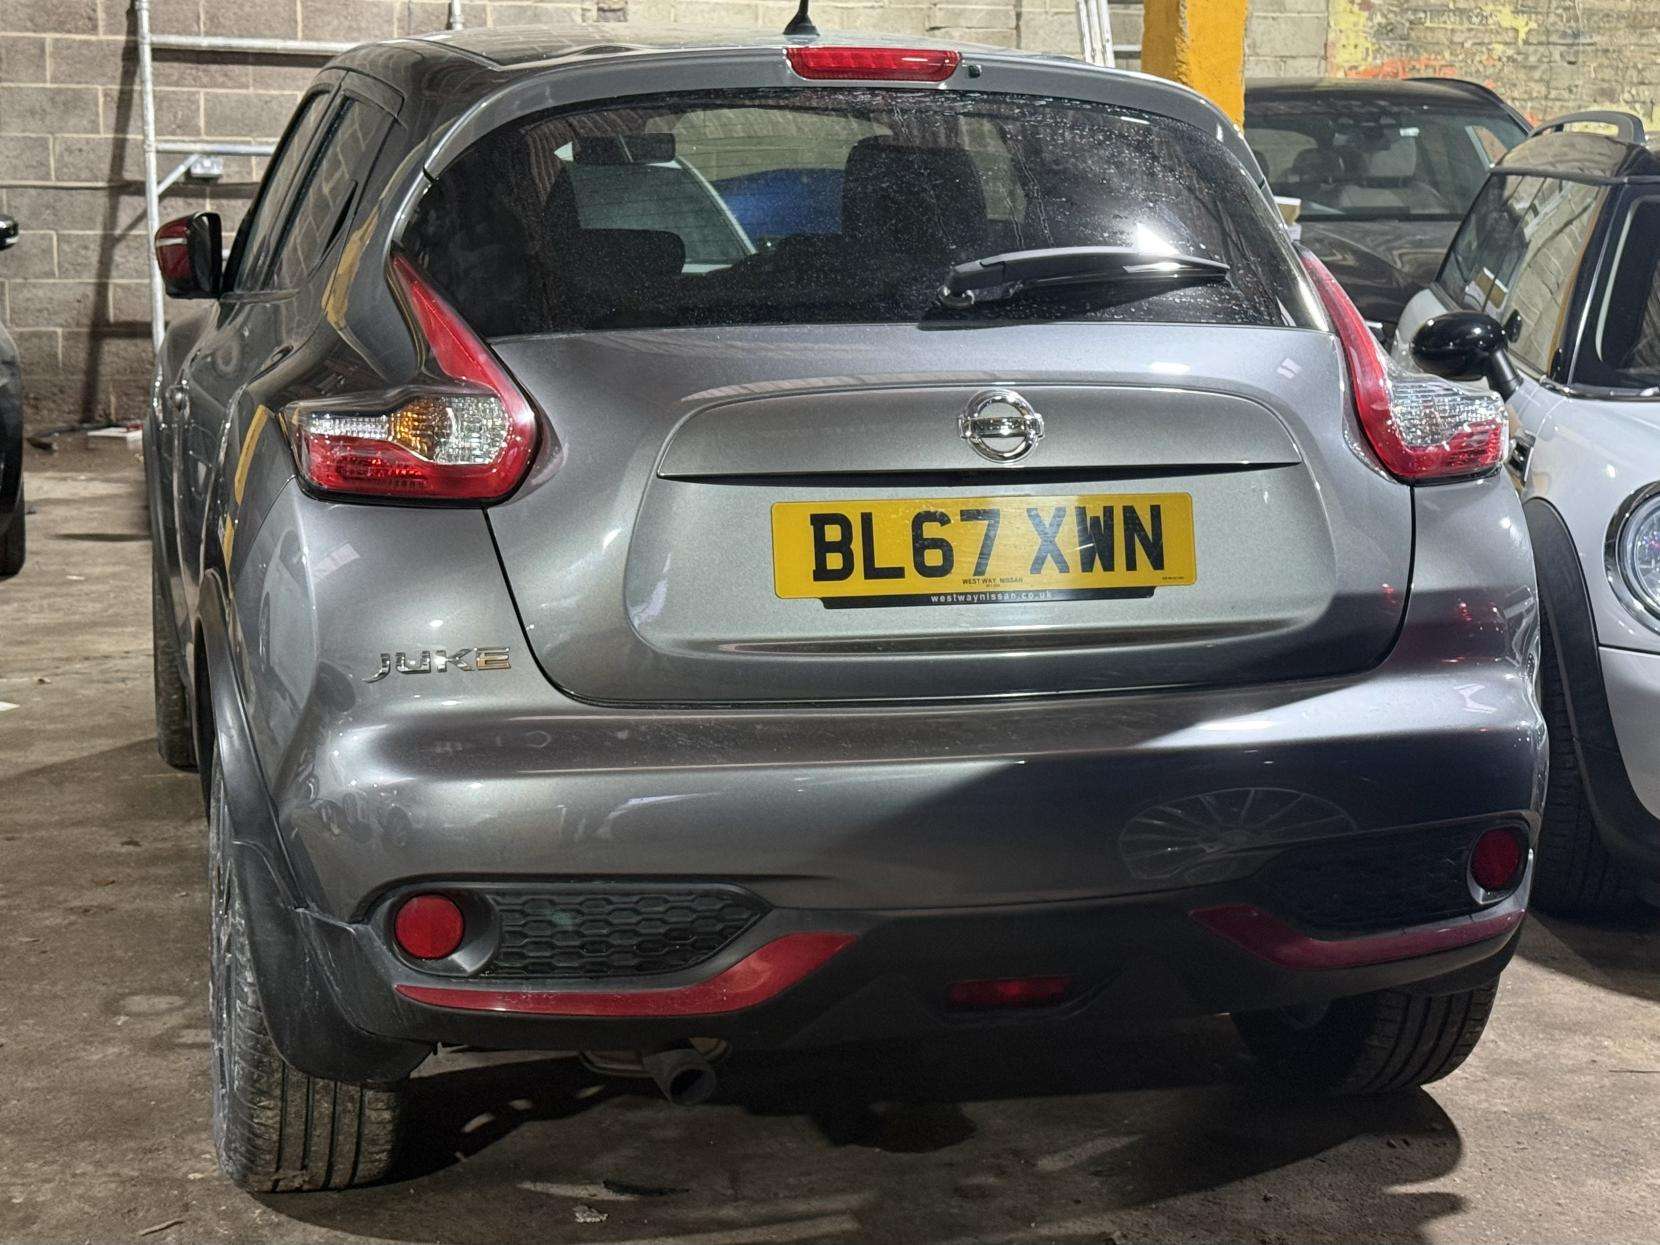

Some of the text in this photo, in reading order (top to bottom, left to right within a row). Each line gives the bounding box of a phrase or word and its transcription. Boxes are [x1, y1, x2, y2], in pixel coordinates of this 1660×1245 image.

[810, 504, 1165, 582] BL67 XWN
[930, 591, 1053, 603] westwaynissan.co.uk
[362, 646, 512, 683] JUKE
